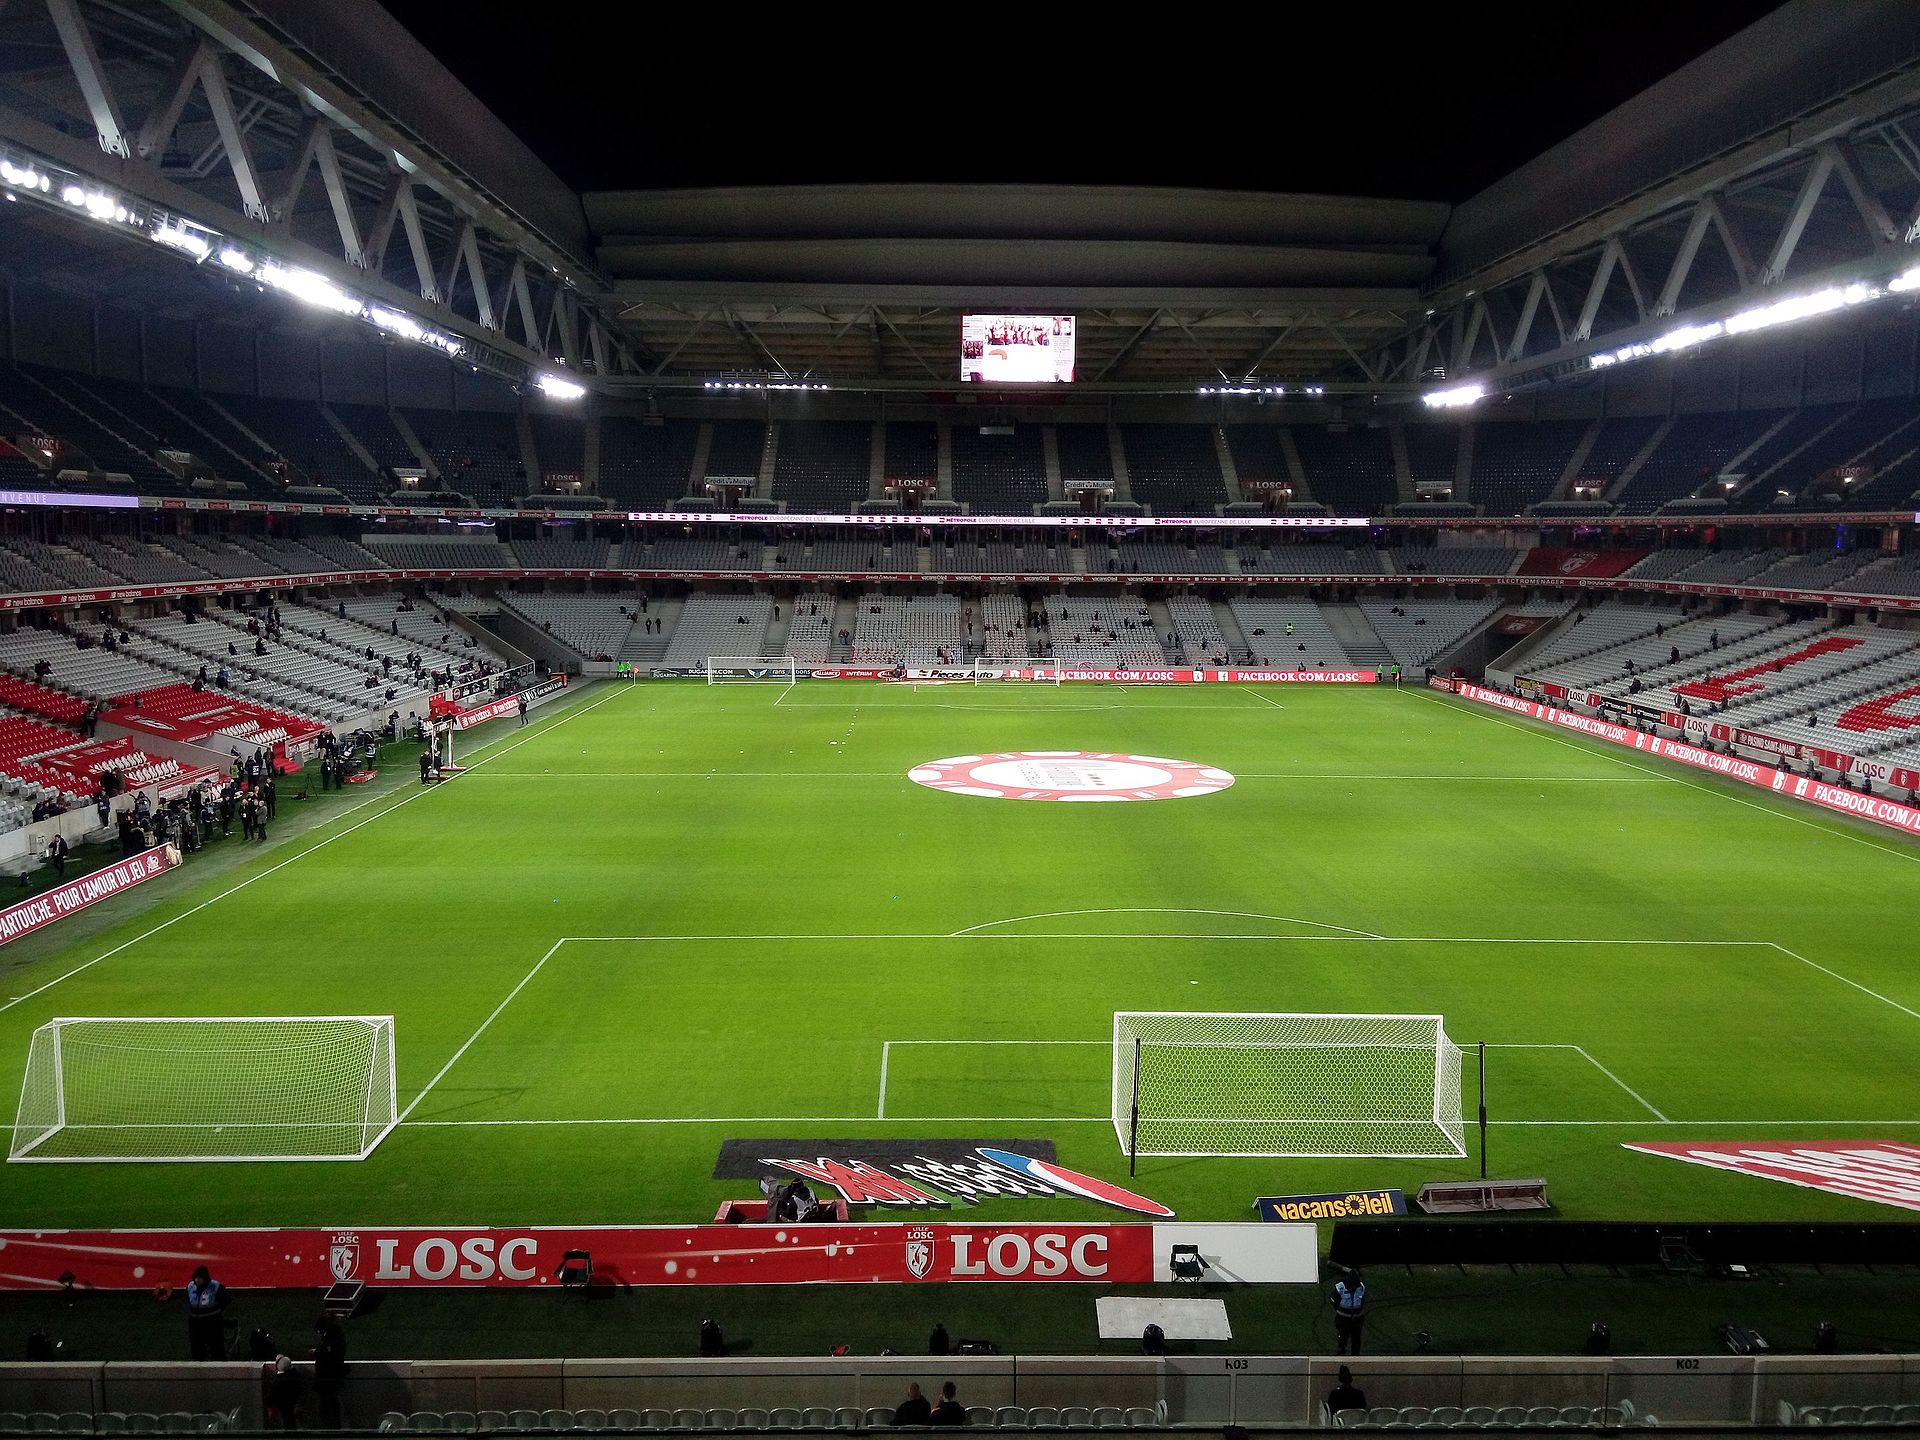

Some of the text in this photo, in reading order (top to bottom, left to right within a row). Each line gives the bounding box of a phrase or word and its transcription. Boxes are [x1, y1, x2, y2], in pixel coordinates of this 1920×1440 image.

[898, 479, 923, 487] LOSC
[1256, 481, 1282, 489] LOSC
[1237, 672, 1359, 682] FACEBOOK.COM/LOSC
[1477, 689, 1530, 713] FACEBOOK.COM/LOSC
[1569, 691, 1585, 702] LOSC
[1558, 711, 1627, 741] FACEBOOK.COM/LOSC
[1688, 719, 1708, 733] LOSC
[1664, 742, 1759, 780] FACEBOOK.COM/LOSC
[1855, 760, 1886, 779] LOSC
[54, 887, 83, 913] POUR
[79, 872, 120, 901] L'AMOUR
[115, 867, 131, 887] DU
[130, 860, 146, 881] JEU
[332, 1236, 360, 1244] LOSC
[907, 1231, 934, 1239] LOSC
[375, 1237, 538, 1281] LOSC
[950, 1233, 1108, 1277] LOSC
[1677, 1359, 1700, 1369] K02
